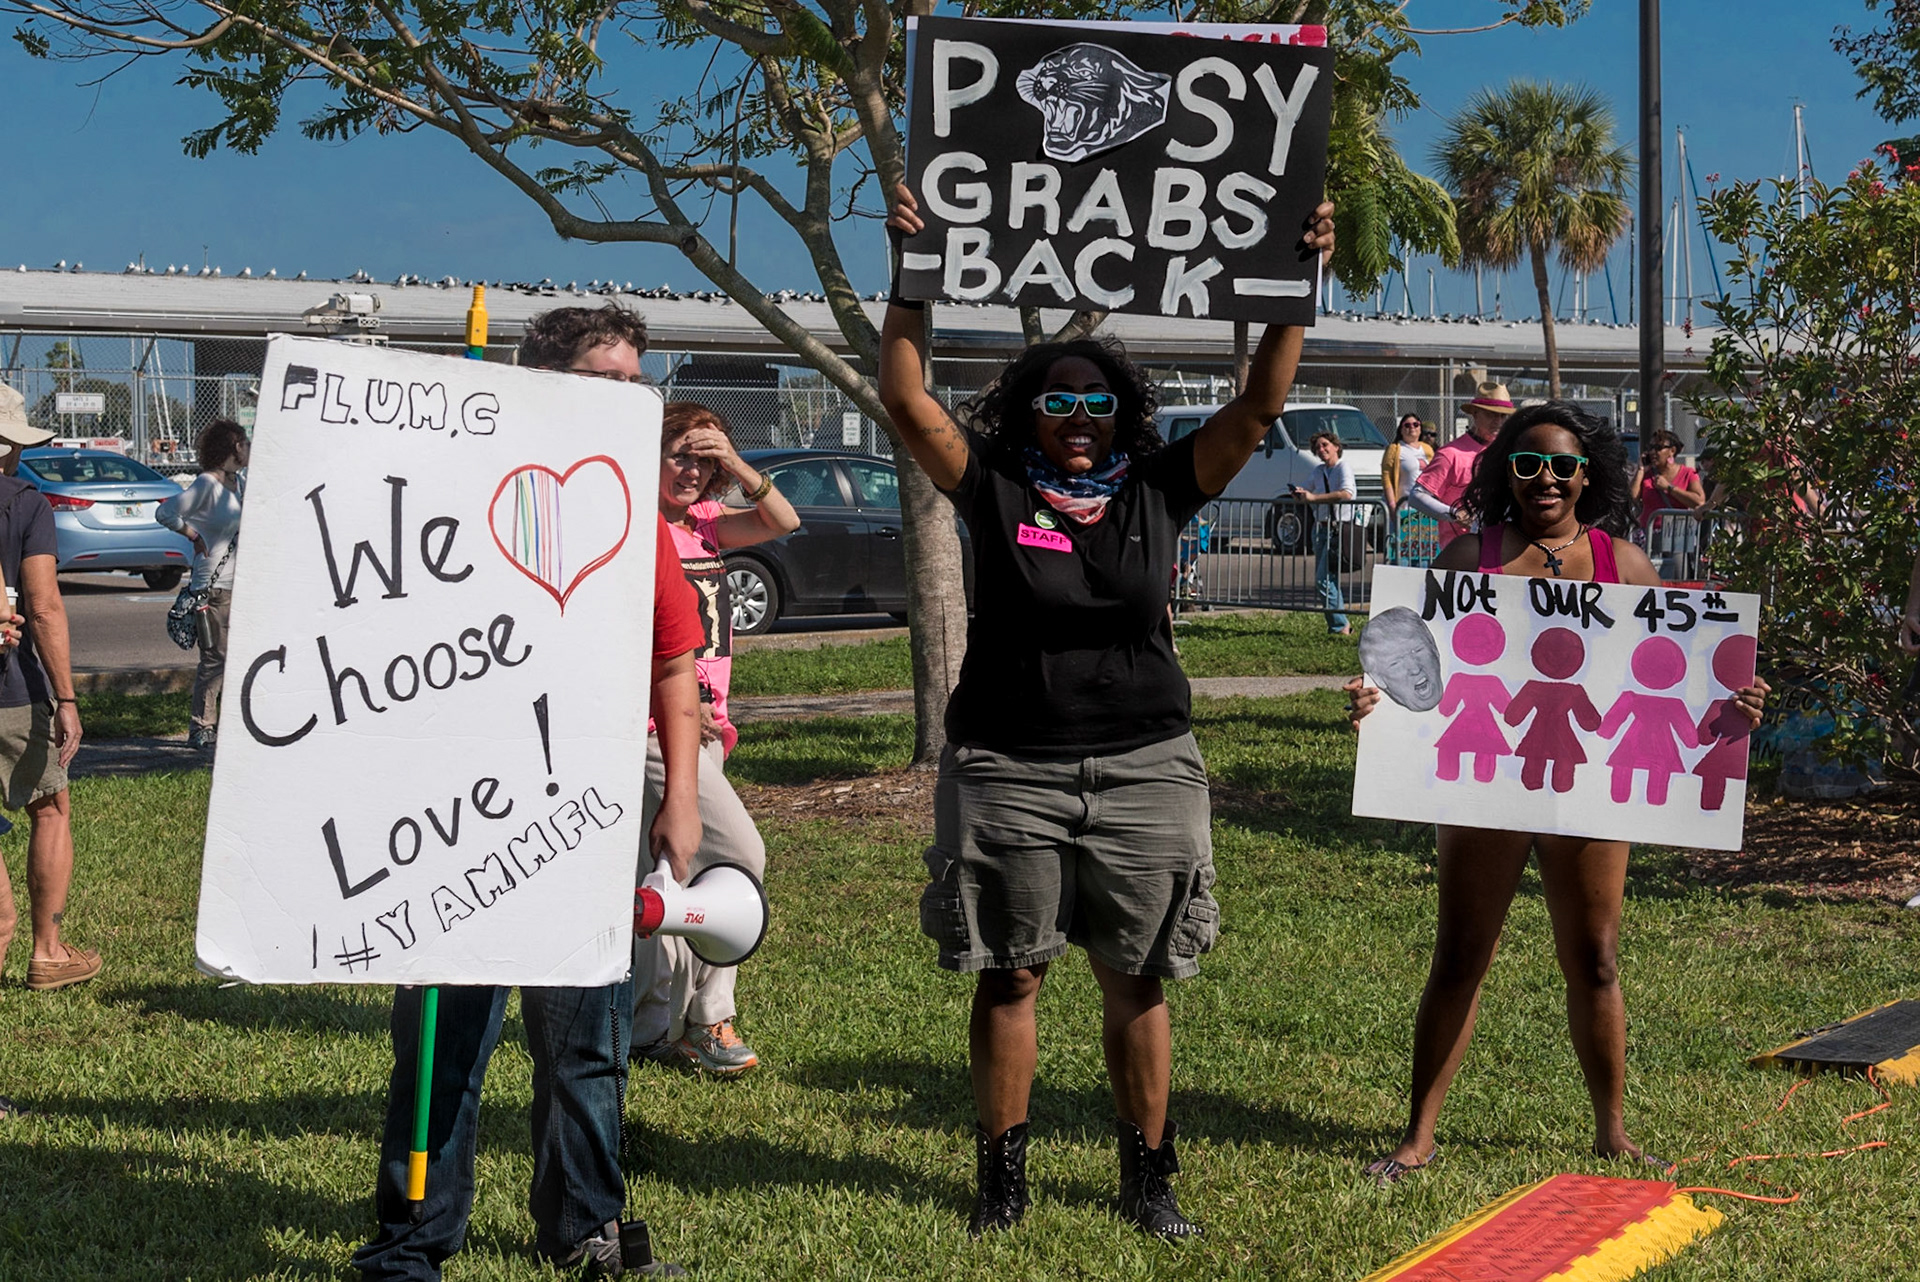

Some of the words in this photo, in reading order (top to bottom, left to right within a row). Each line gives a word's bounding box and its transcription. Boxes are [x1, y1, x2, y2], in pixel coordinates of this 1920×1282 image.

[920, 151, 1277, 252] GRABS
[305, 475, 474, 609] We
[1020, 529, 1067, 544] STAFF
[239, 613, 533, 748] Choose
[684, 913, 705, 924] PYLE
